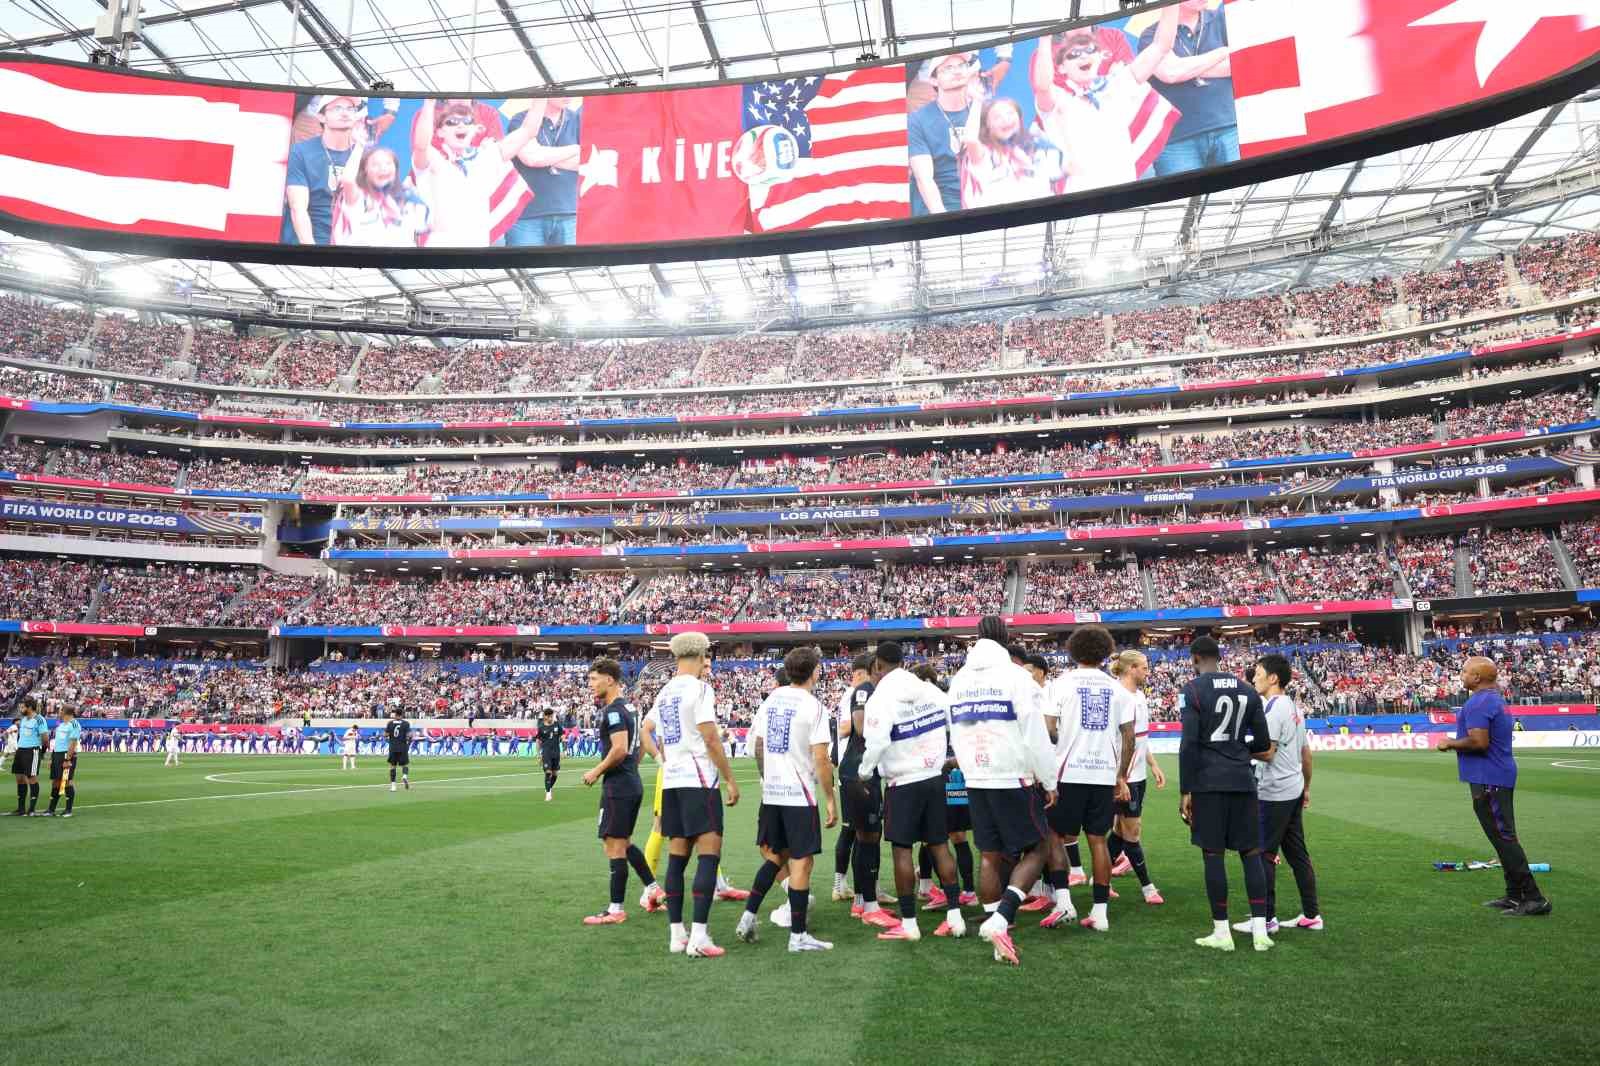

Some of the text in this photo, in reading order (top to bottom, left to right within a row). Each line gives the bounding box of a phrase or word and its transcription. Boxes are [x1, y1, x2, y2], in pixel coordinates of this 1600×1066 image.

[1371, 463, 1508, 487] FIFA WORLD CUP 2026
[3, 503, 178, 527] FIFA WORLD CUP 2026
[780, 509, 880, 520] LOS ANGELES
[1212, 678, 1238, 689] WEAH
[1210, 694, 1248, 742] 21
[393, 724, 401, 738] 6
[1306, 733, 1430, 751] McDonald's
